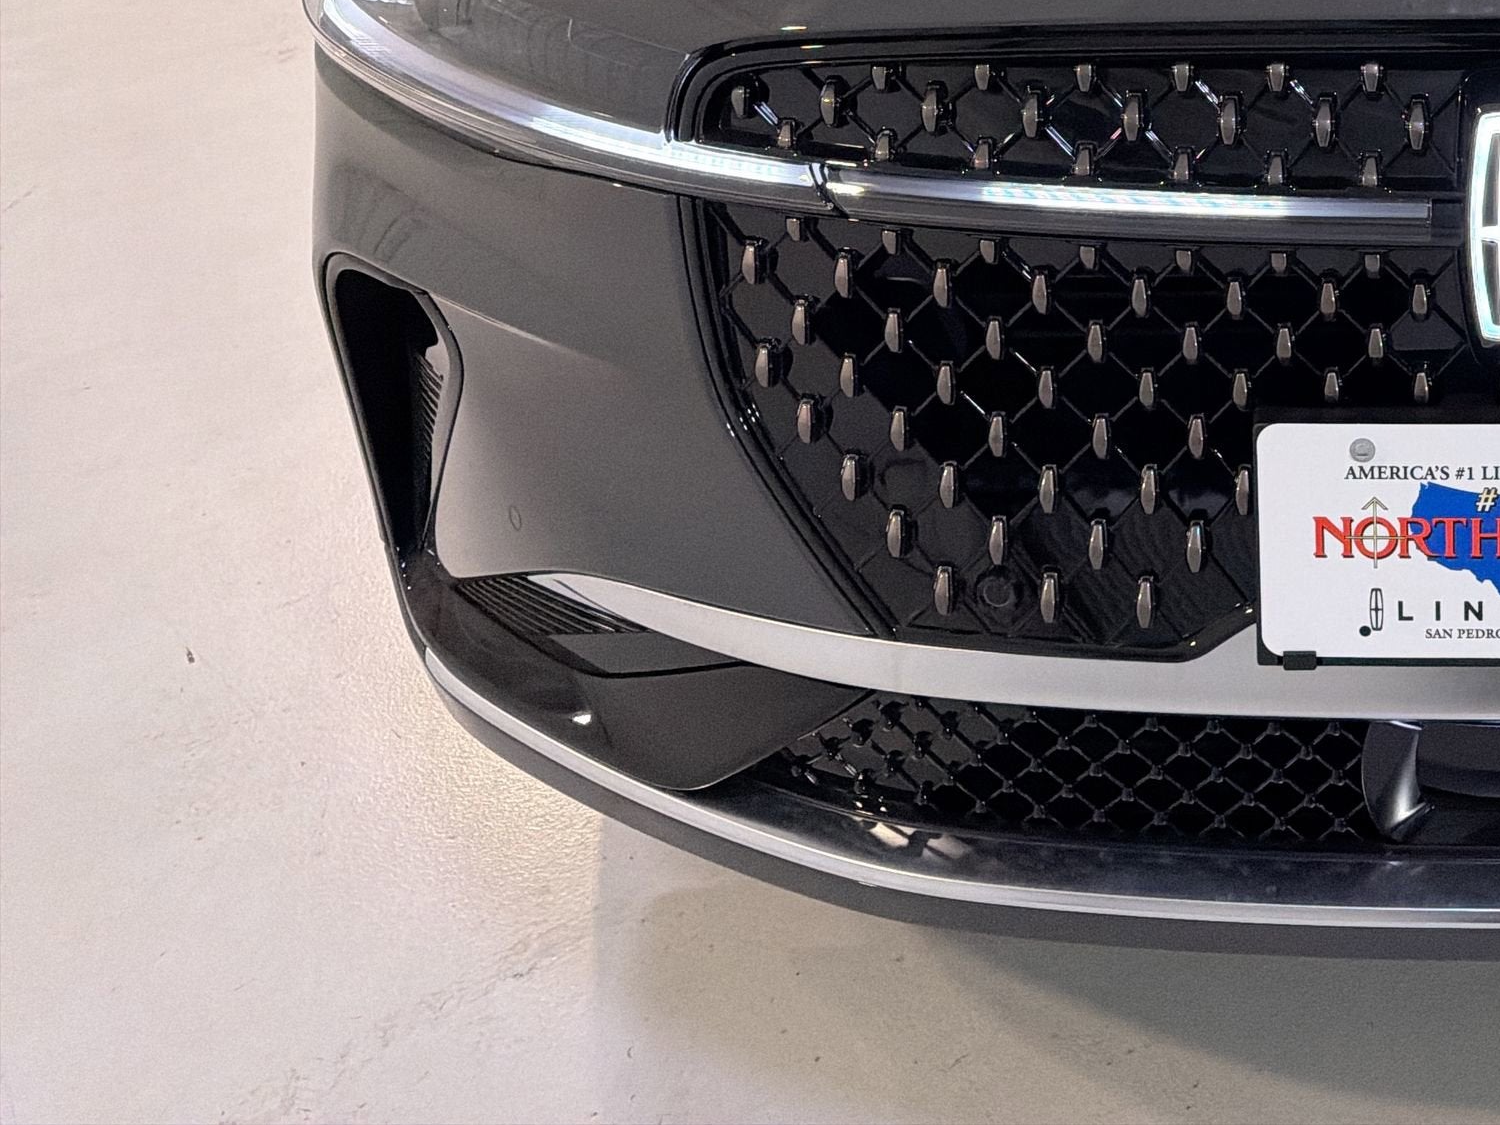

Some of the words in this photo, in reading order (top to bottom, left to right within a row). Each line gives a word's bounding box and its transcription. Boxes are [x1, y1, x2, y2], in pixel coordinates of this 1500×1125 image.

[1344, 464, 1450, 481] AMERICA'S
[1454, 465, 1478, 481] #1
[1425, 628, 1453, 640] SAN
